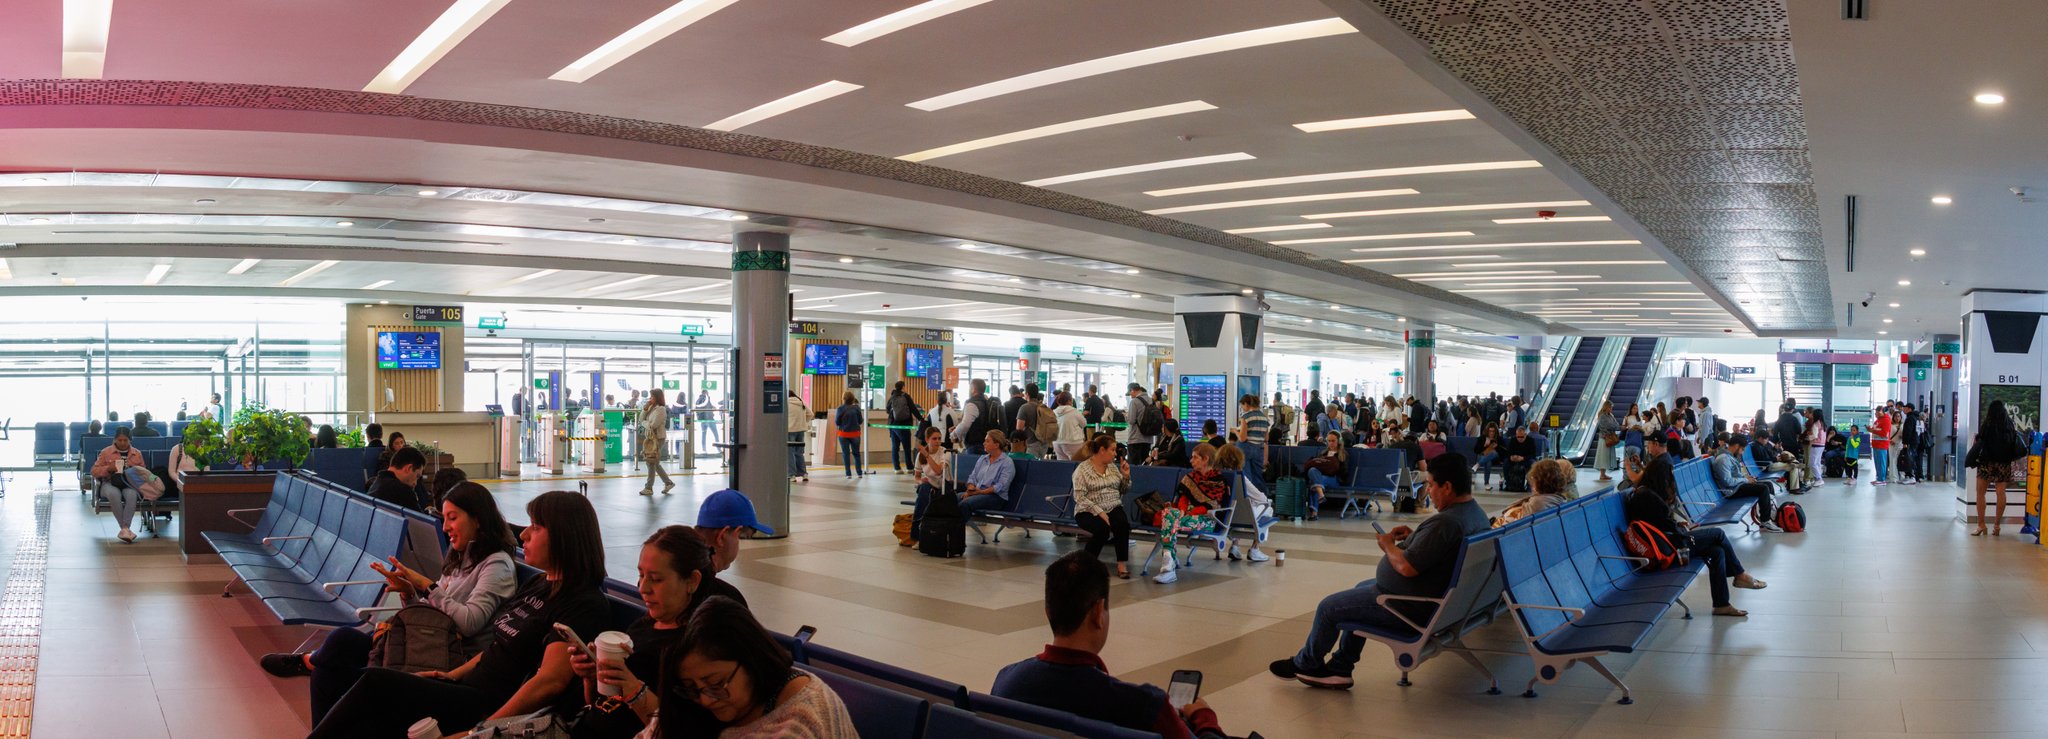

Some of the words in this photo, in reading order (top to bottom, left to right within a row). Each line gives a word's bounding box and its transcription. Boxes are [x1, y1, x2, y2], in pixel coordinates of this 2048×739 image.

[441, 308, 460, 319] 105
[803, 323, 816, 333] 104
[941, 331, 953, 340] 103
[870, 371, 876, 381] 2
[1999, 375, 2005, 383] B
[2008, 375, 2019, 383] 01
